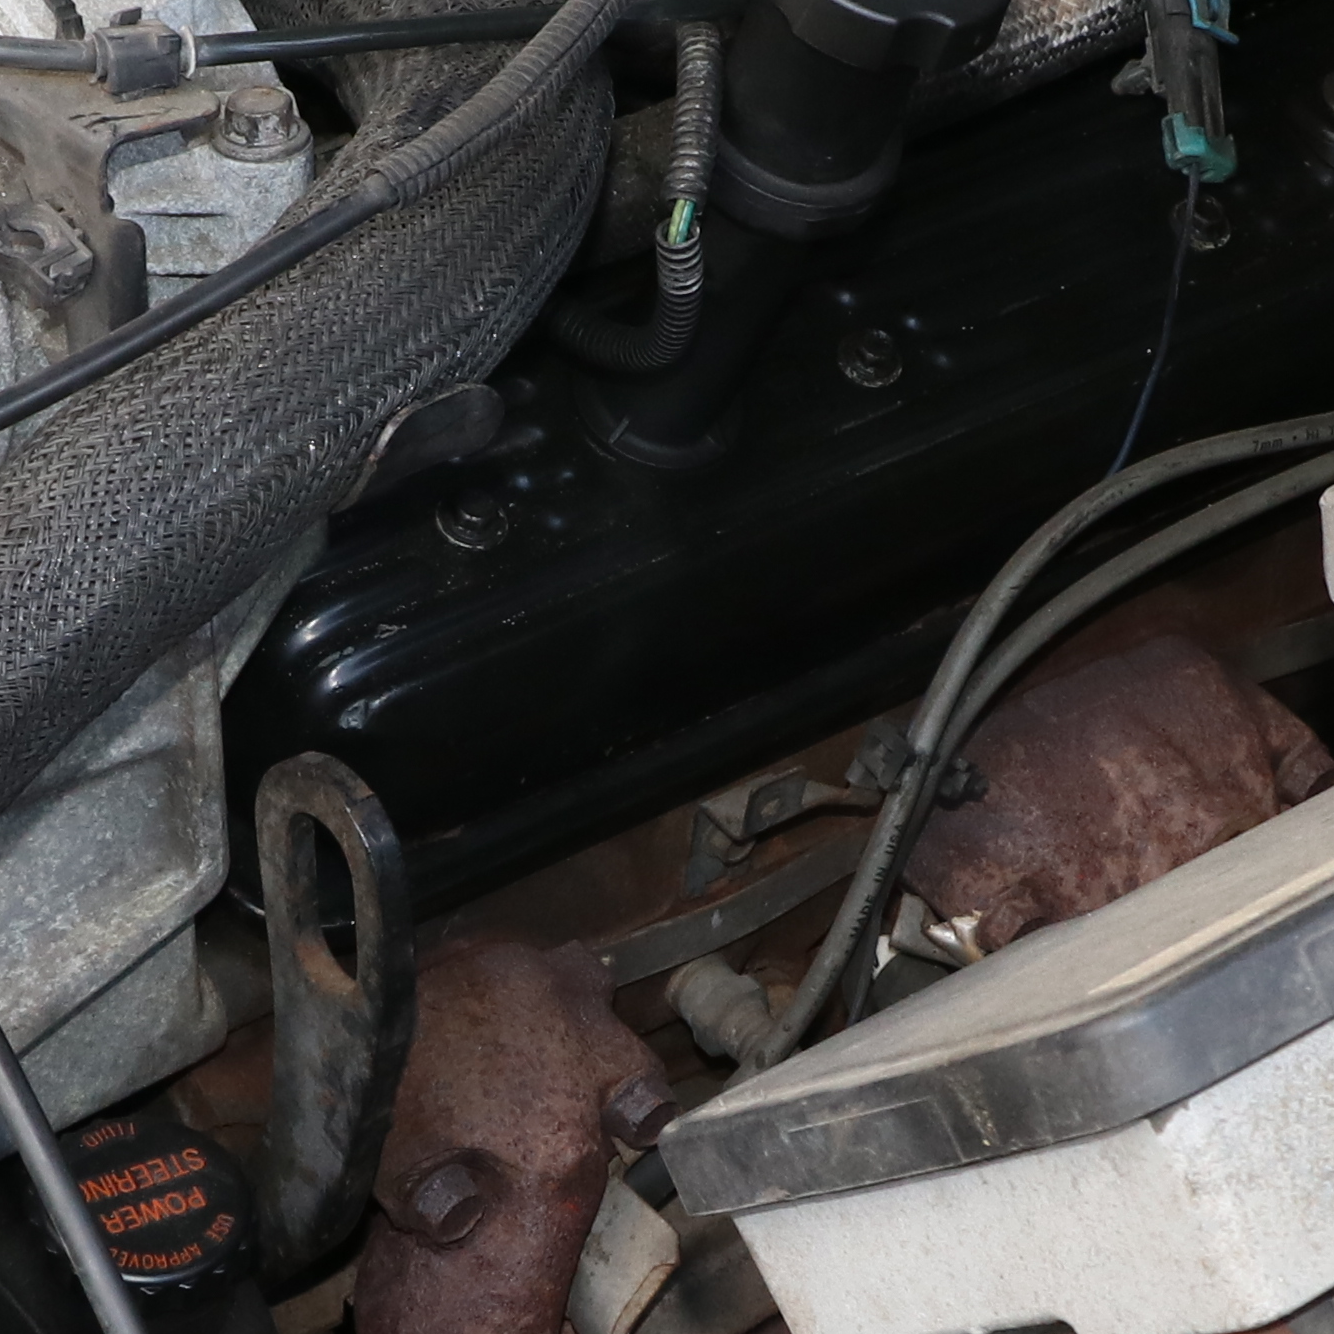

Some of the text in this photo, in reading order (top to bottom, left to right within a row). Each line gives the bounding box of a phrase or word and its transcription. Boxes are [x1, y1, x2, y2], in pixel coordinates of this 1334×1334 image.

[1252, 438, 1284, 453] 7mm
[850, 824, 906, 938] MADE IN USA
[100, 1186, 208, 1235] POWER
[204, 1213, 236, 1244] USE
